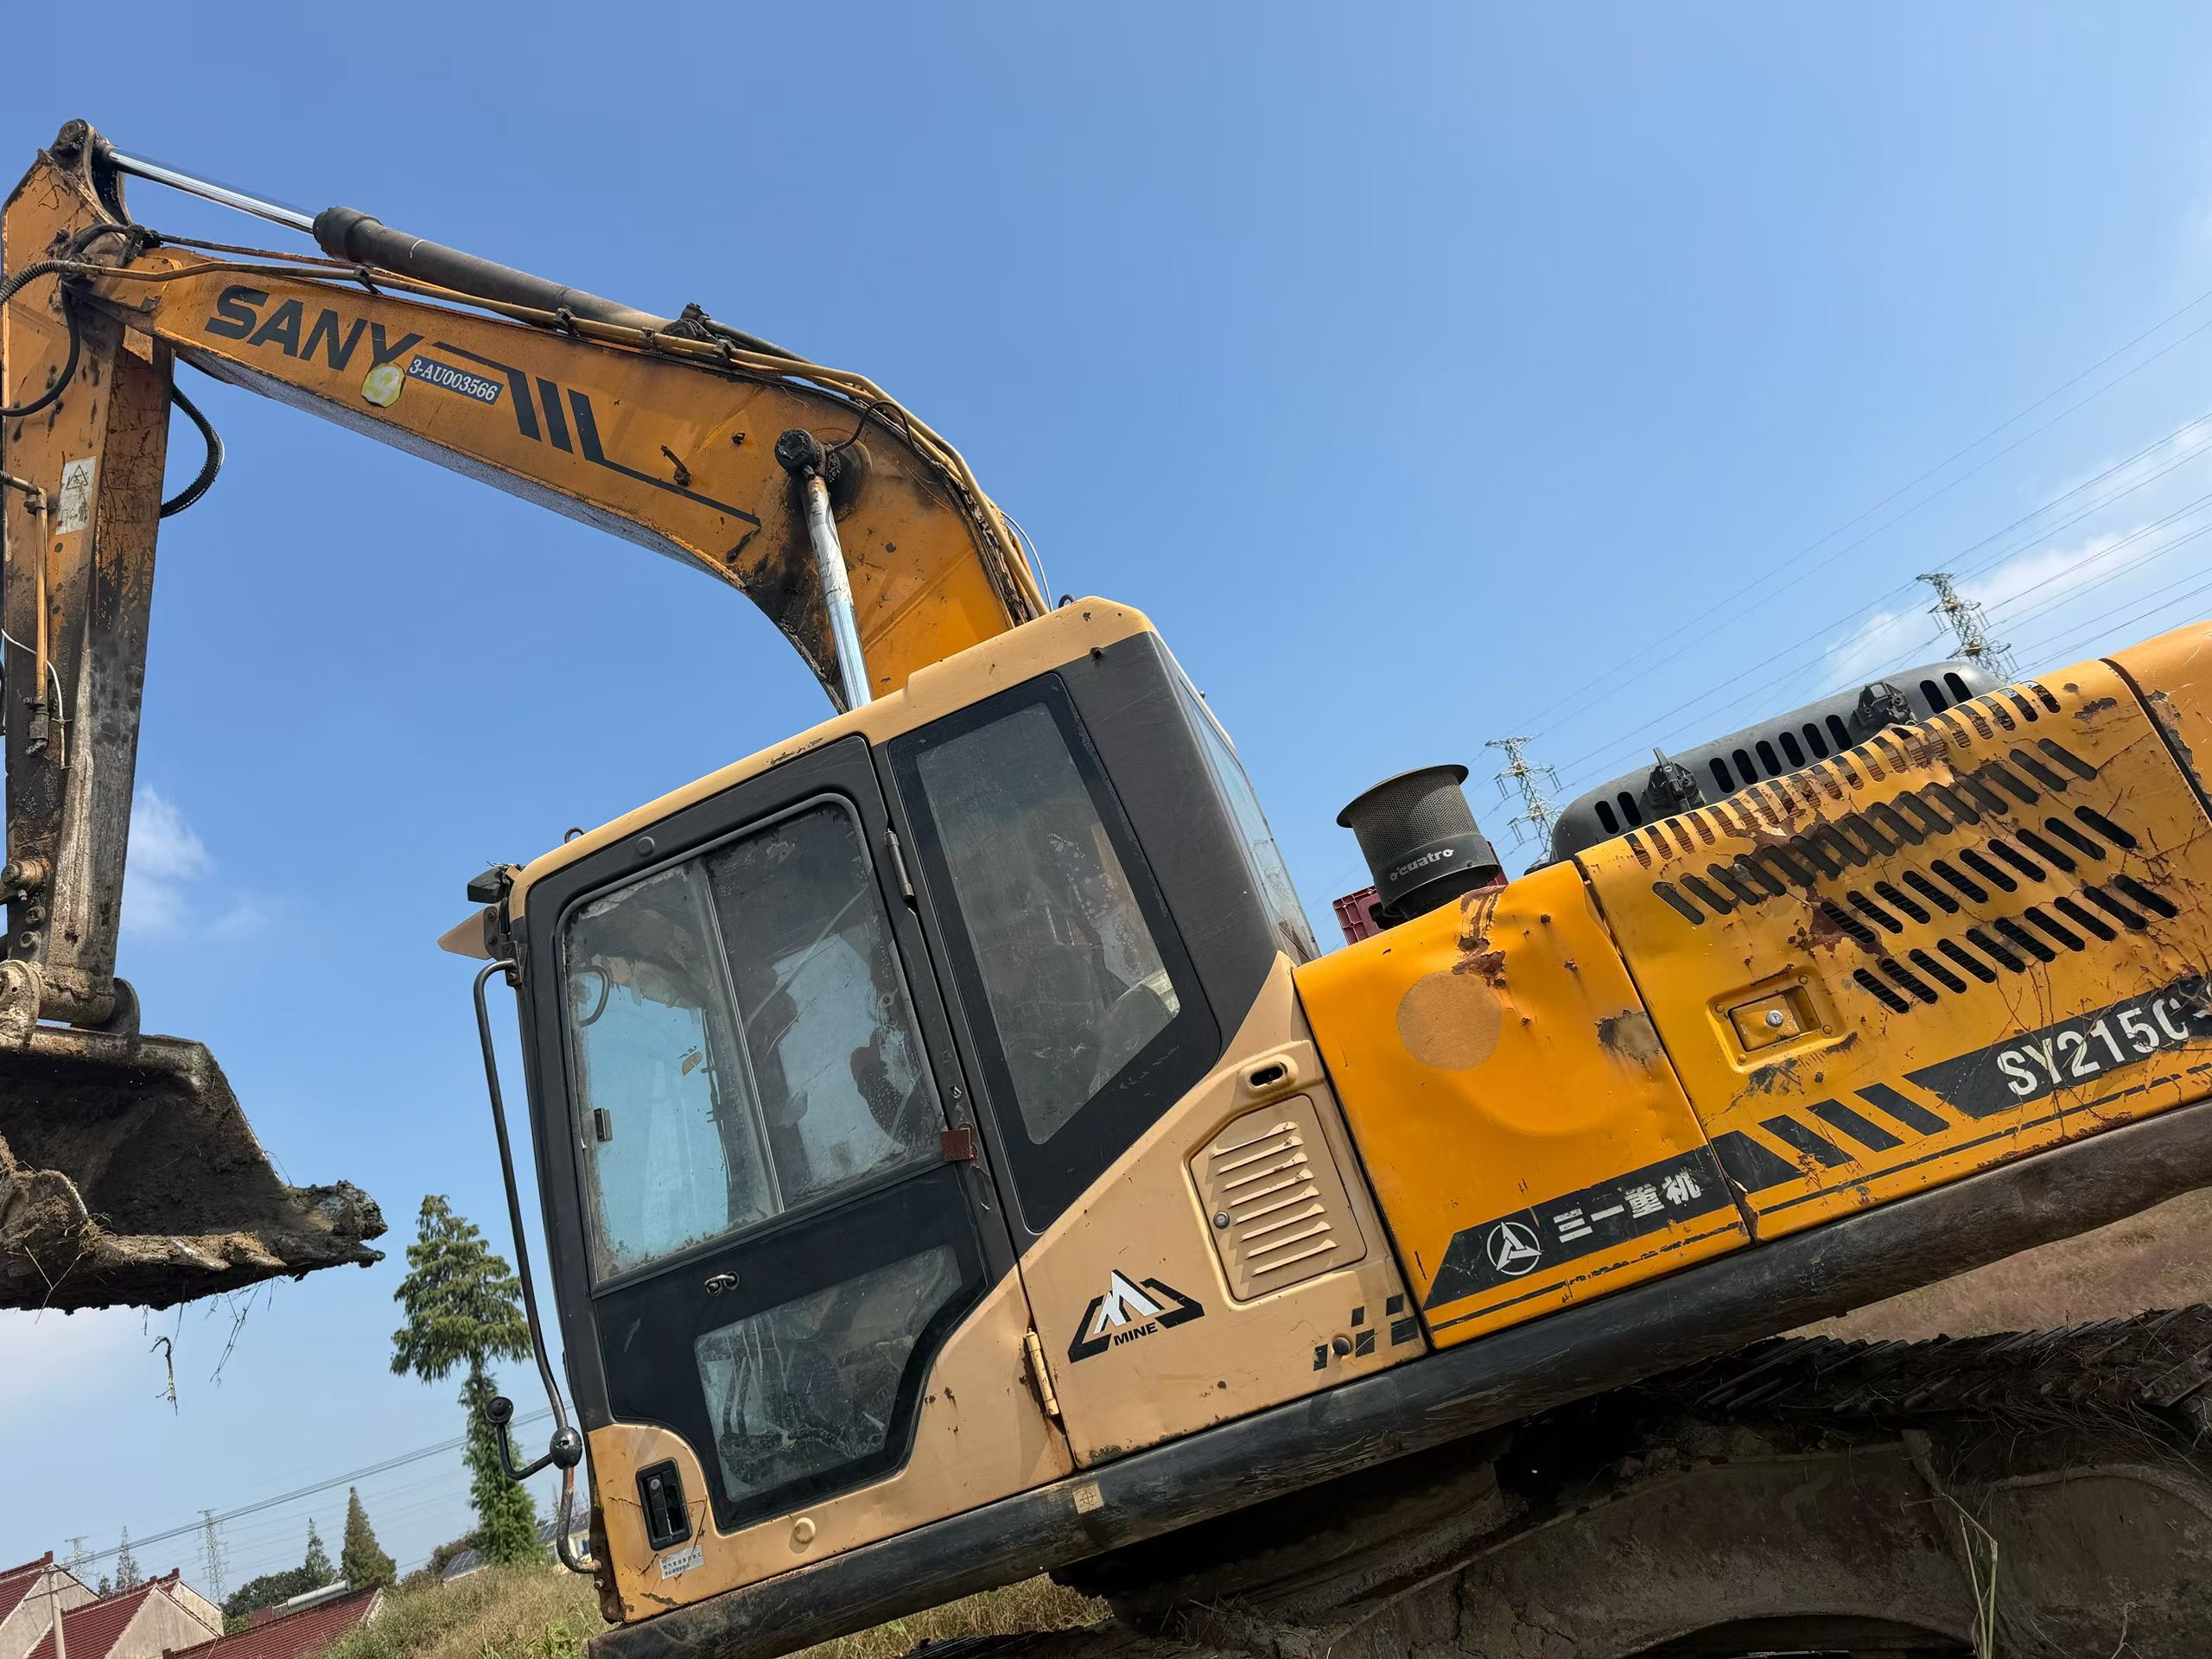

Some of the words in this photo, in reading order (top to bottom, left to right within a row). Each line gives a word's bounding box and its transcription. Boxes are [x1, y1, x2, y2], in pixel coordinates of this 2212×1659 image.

[204, 284, 424, 373] SANY
[409, 359, 498, 401] 3-AU003566
[1997, 983, 2212, 1096] SY215C
[1553, 1170, 1701, 1243] 三一重机
[1113, 1321, 1159, 1346] MINE
